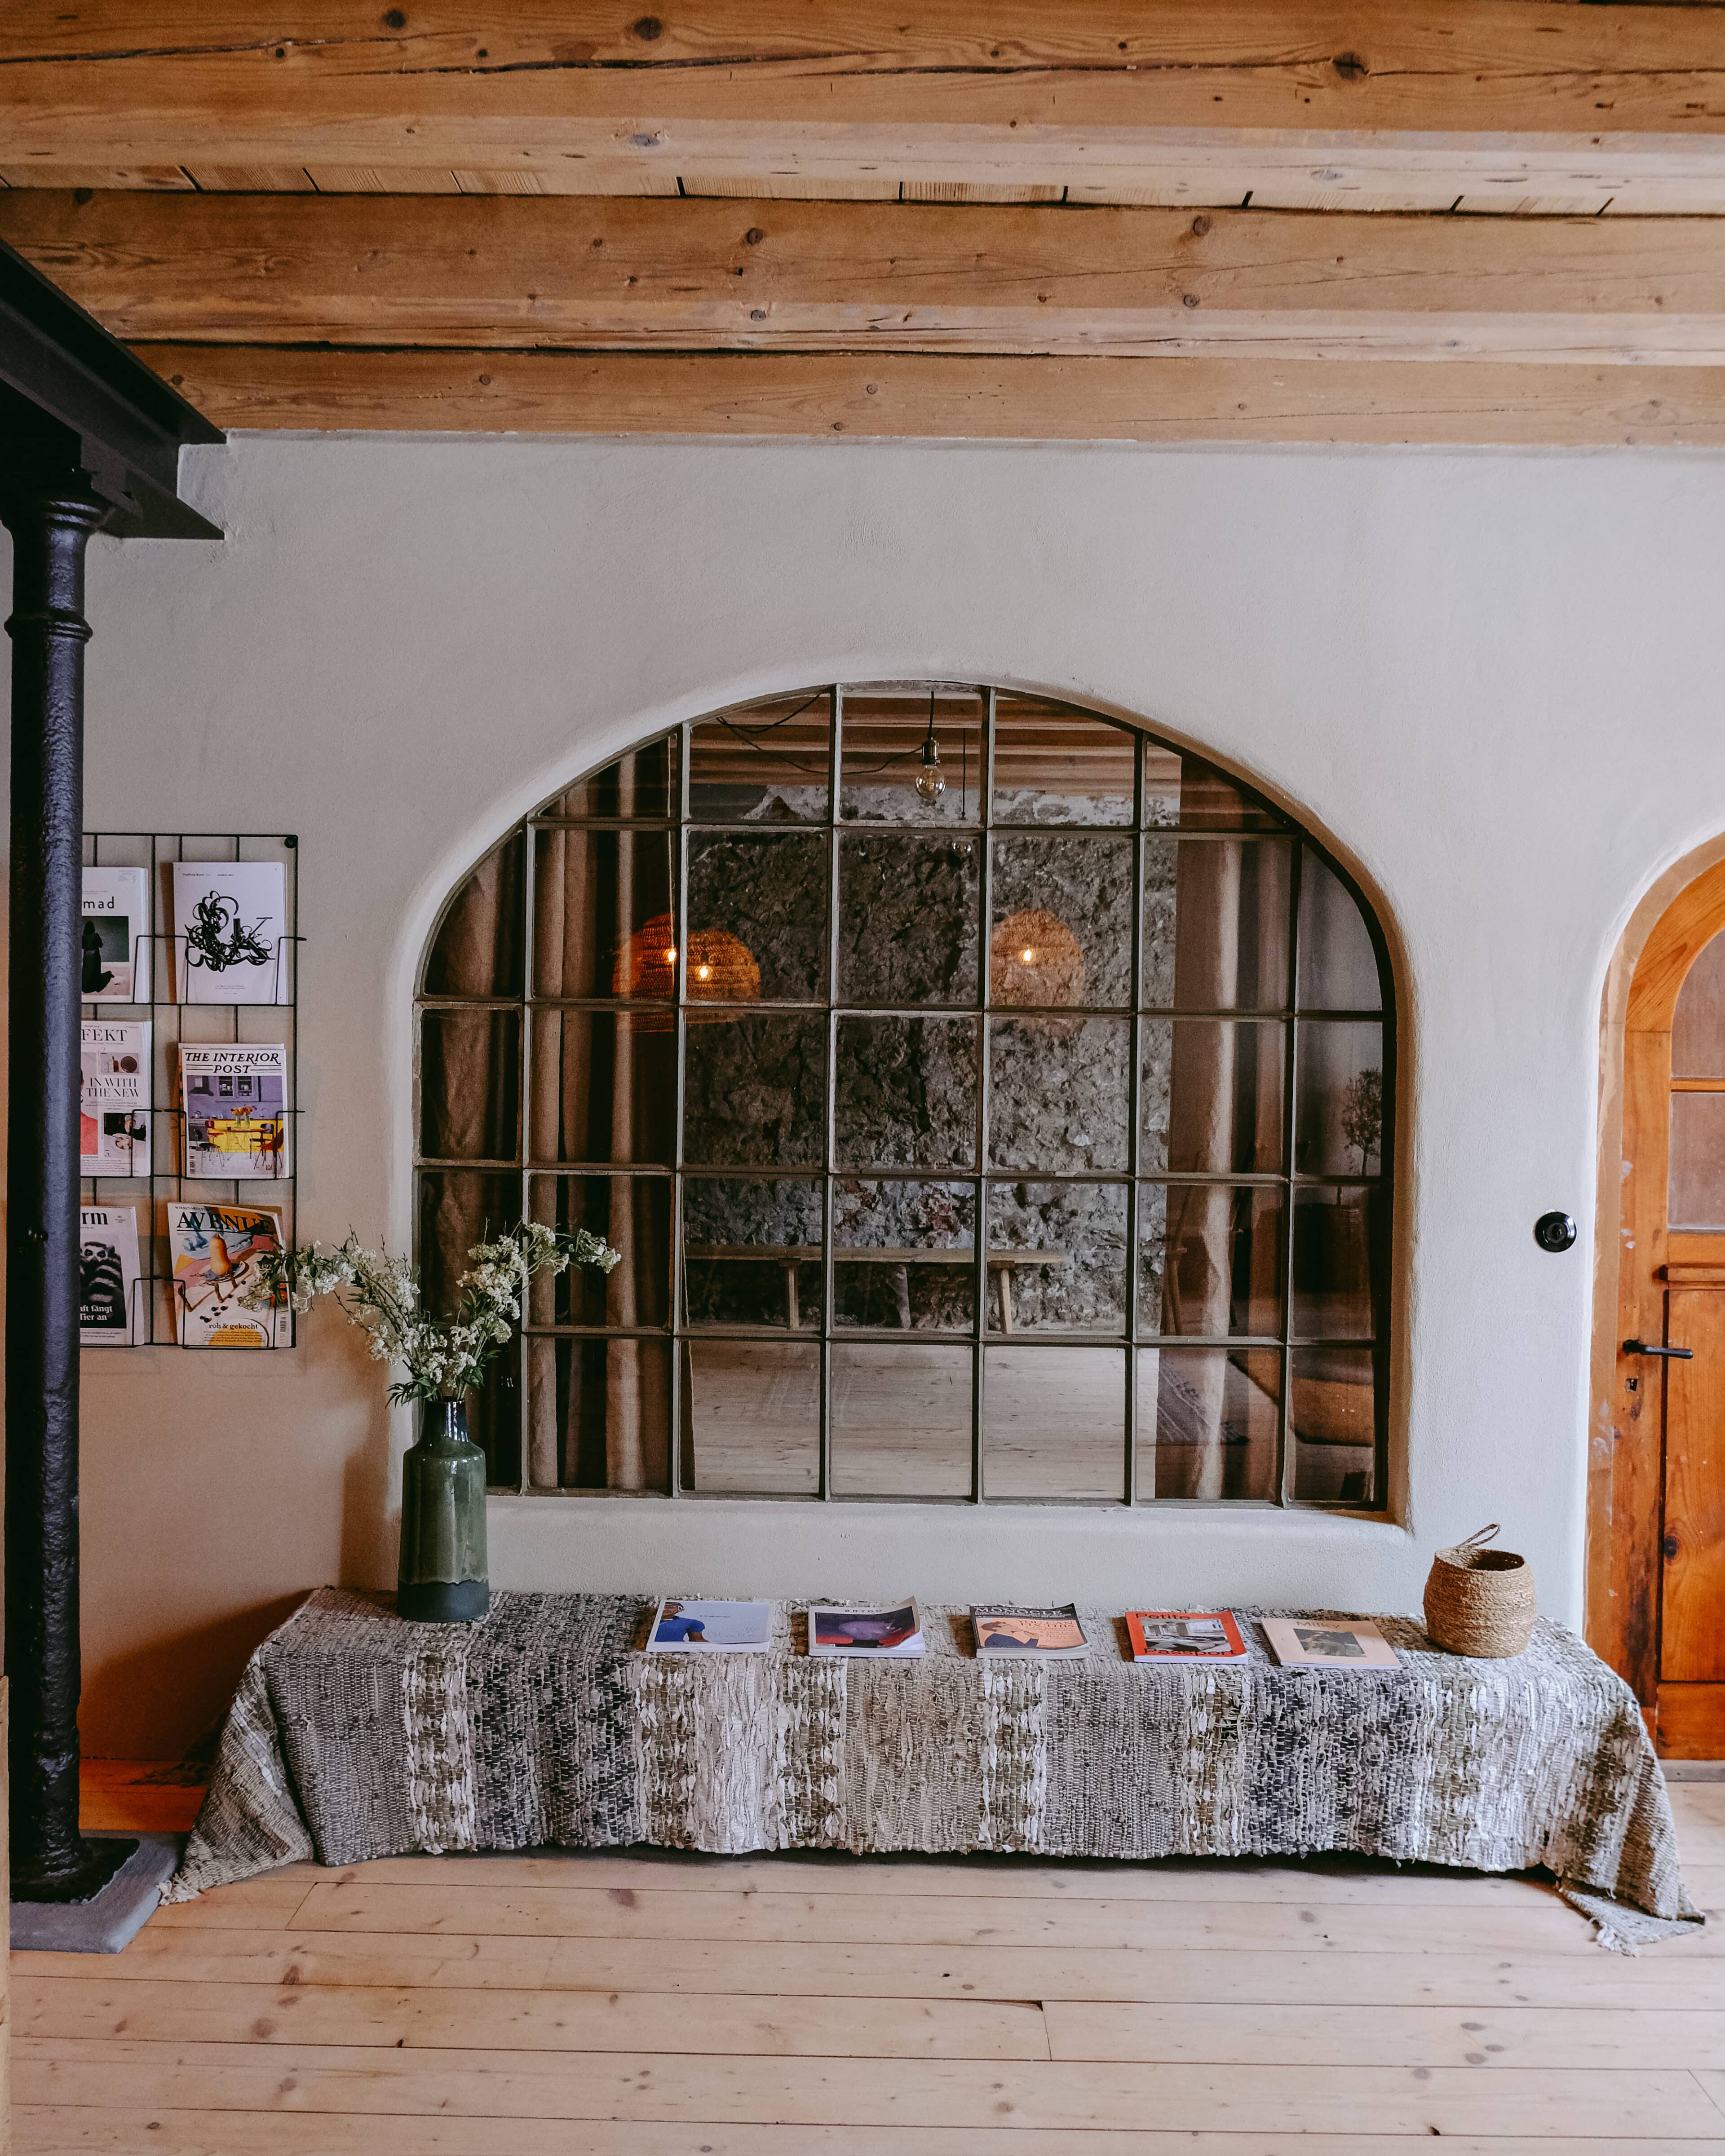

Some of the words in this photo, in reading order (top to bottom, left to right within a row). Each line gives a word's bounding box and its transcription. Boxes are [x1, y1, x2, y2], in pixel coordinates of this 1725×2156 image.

[83, 896, 115, 909] mad
[185, 1052, 210, 1061] THE
[213, 1053, 281, 1065] INTERIOR
[213, 1065, 252, 1074] POST
[90, 1078, 102, 1087] IN
[104, 1078, 136, 1087] WITH
[86, 1087, 110, 1097] THE
[113, 1088, 141, 1097] NEW
[81, 1212, 108, 1225] rm
[176, 1211, 274, 1235] AVENUE
[91, 1305, 112, 1313] fängt
[1144, 1648, 1237, 1657] Passport
